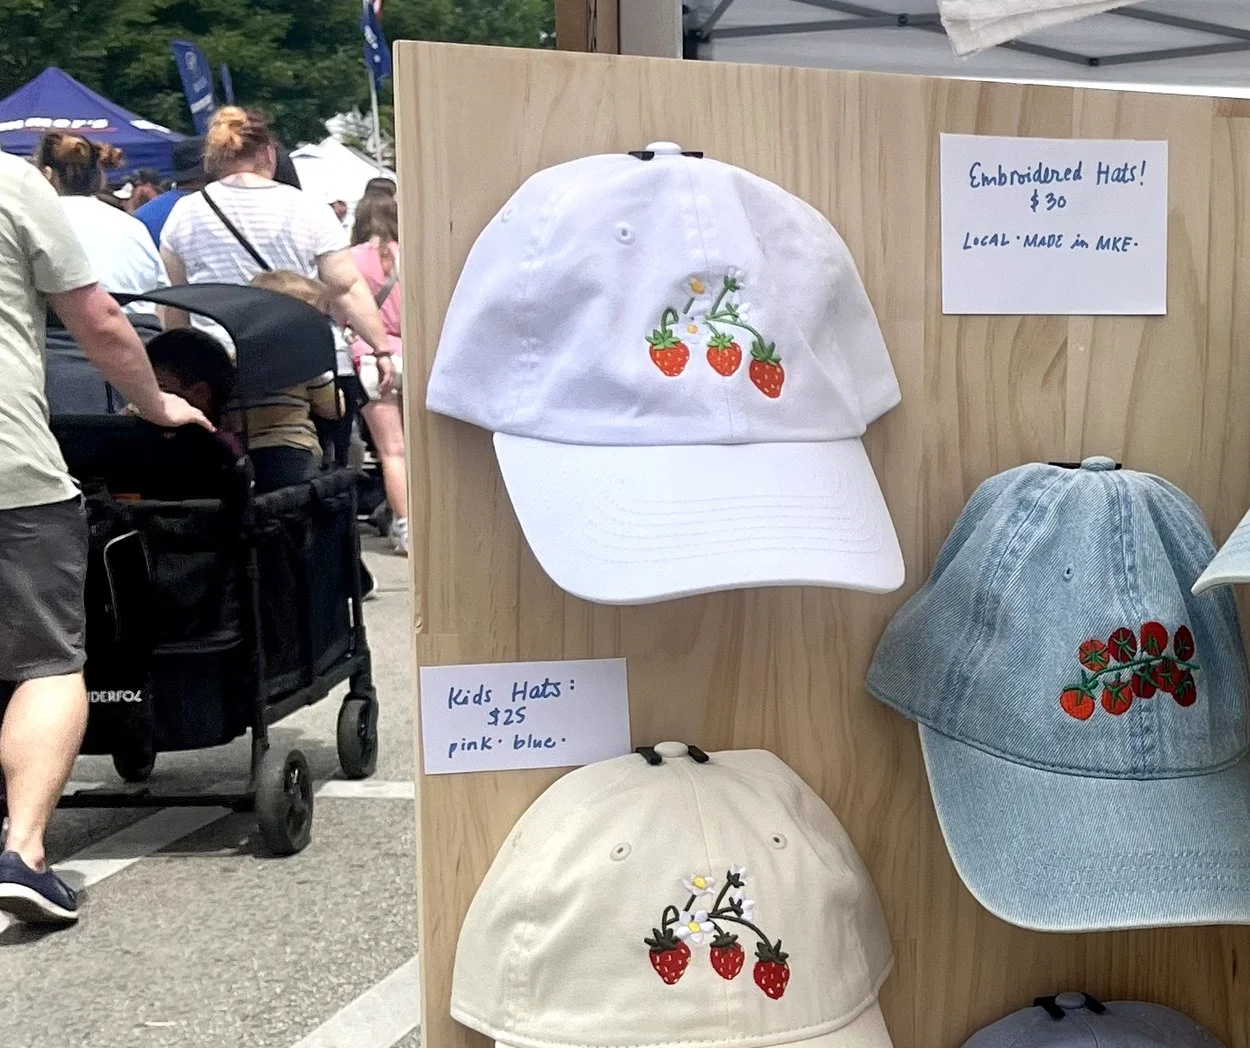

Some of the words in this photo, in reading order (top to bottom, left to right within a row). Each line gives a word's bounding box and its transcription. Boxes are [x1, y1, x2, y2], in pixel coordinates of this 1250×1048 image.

[969, 161, 1083, 189] Embroidered
[1096, 160, 1146, 186] Hats!
[963, 232, 1010, 251] LOCAL
[1070, 234, 1089, 249] in
[448, 684, 493, 709] Kids
[512, 678, 575, 703] Hats:
[487, 706, 527, 726] $25
